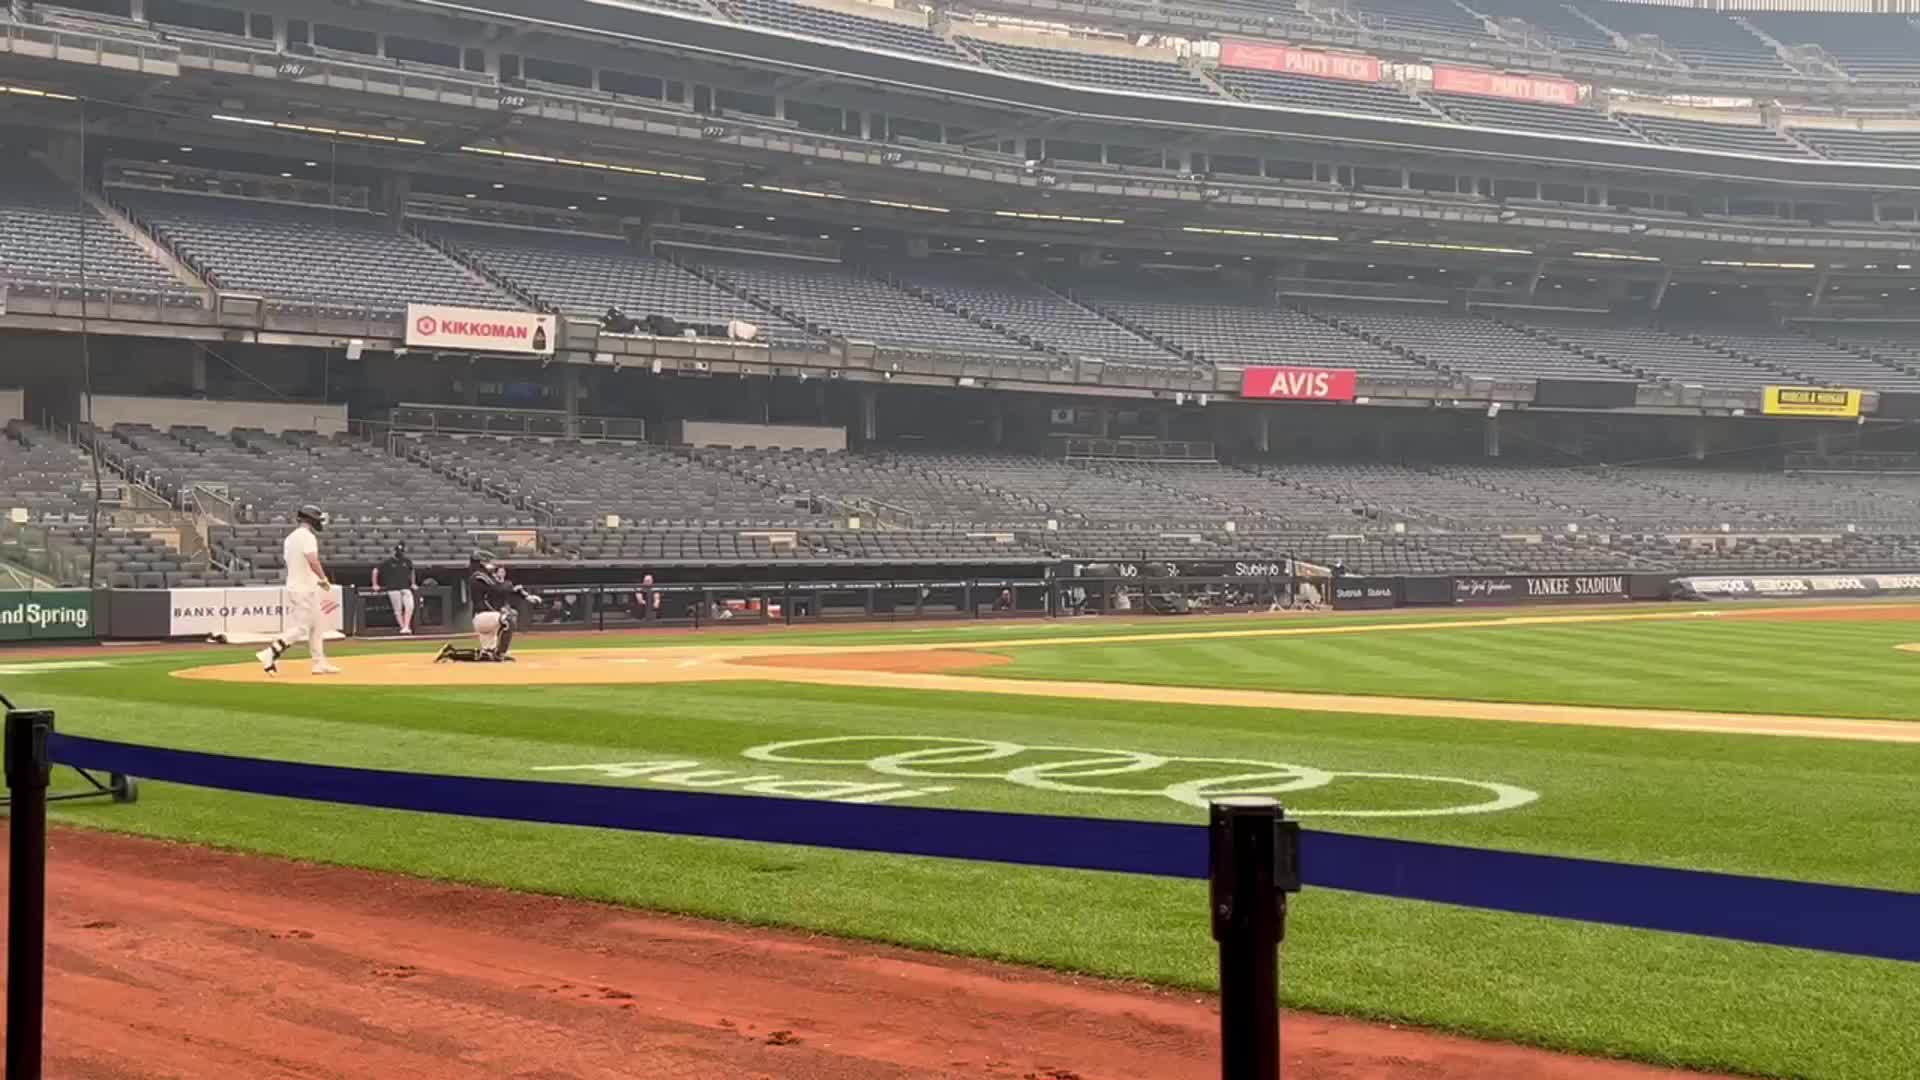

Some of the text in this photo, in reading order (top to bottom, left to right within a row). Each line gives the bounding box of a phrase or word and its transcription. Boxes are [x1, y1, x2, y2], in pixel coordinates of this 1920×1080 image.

[441, 319, 528, 339] KIKKOMAN
[1269, 371, 1329, 397] AVIS
[1527, 576, 1623, 595] YANKEE STADIUM
[26, 603, 88, 628] Spring
[174, 607, 214, 617] BANK
[219, 606, 238, 617] OF
